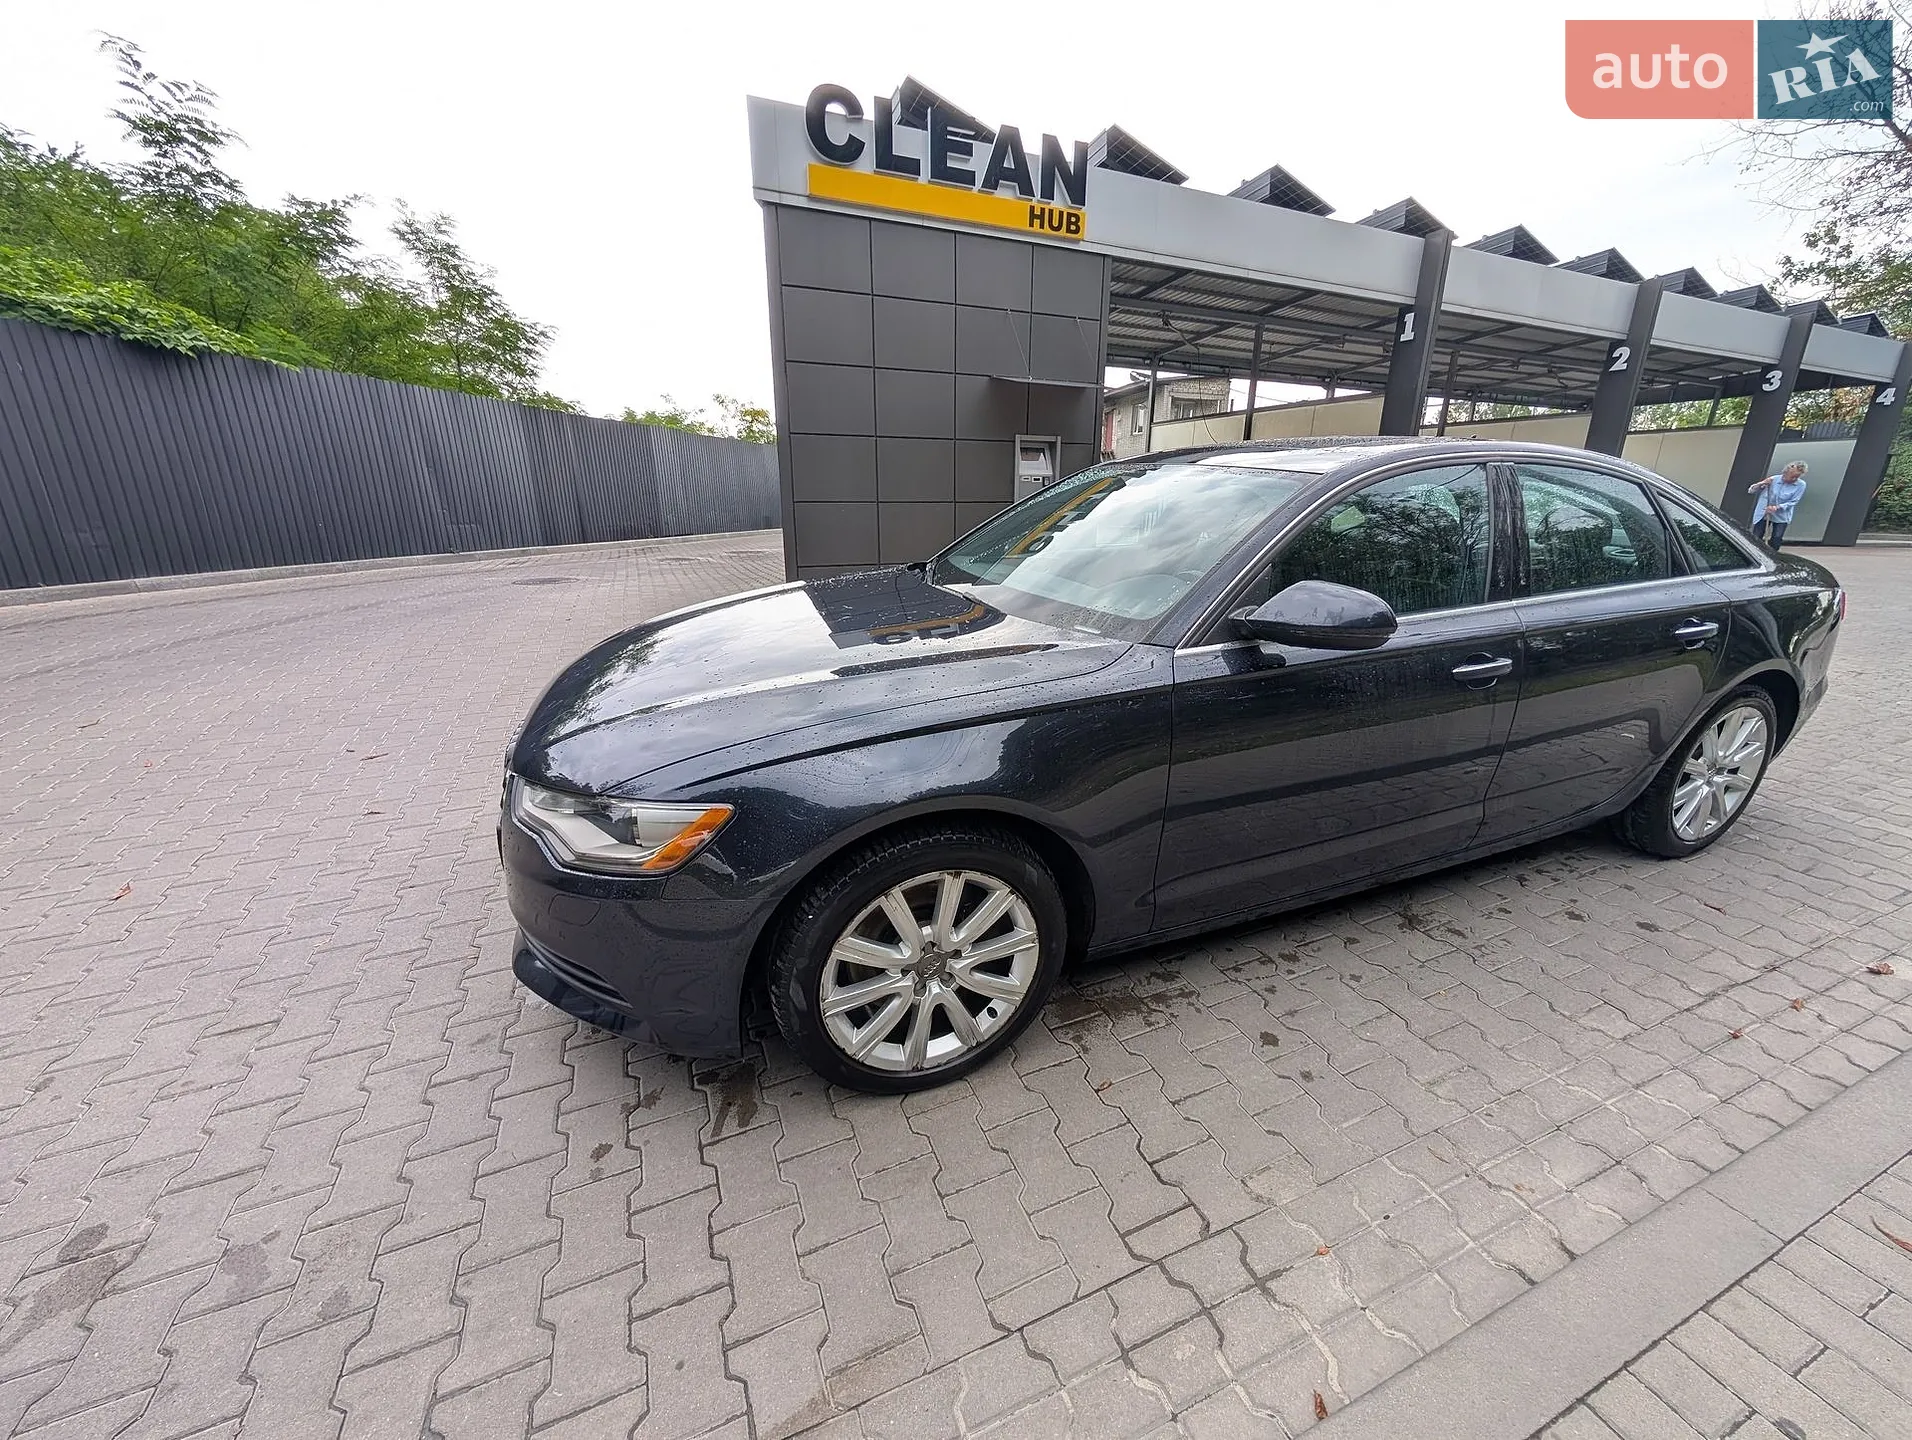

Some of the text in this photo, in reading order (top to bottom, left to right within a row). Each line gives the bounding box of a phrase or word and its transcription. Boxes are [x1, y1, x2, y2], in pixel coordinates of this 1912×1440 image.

[804, 83, 1088, 208] CLEAN
[1028, 204, 1082, 235] HUB
[1399, 312, 1416, 343] 1
[1608, 346, 1631, 372] 2
[1761, 370, 1784, 392] 3
[1875, 387, 1897, 406] 4
